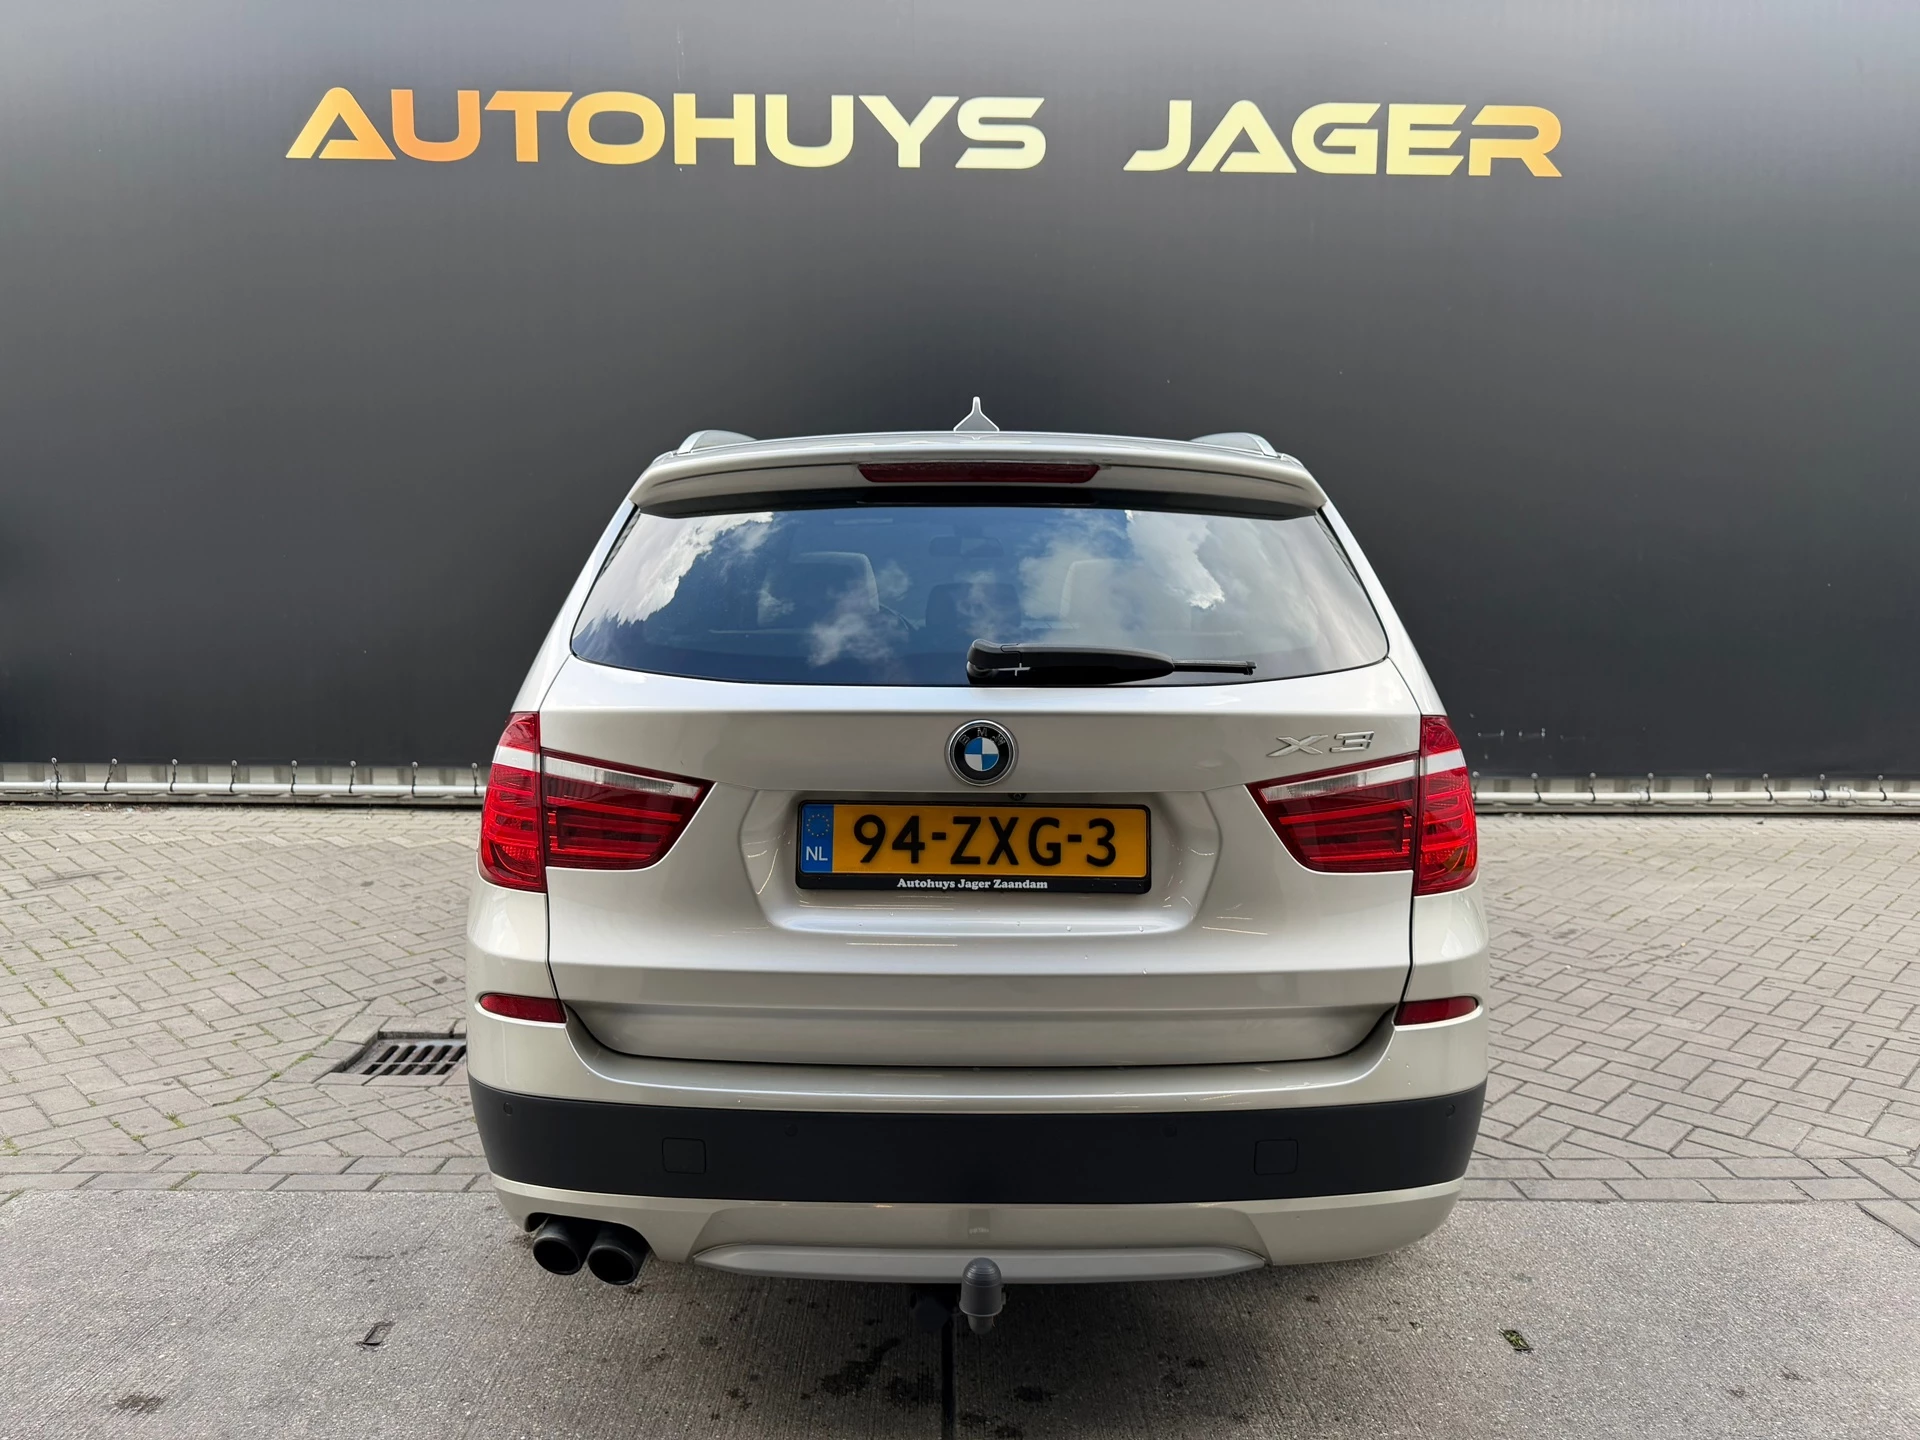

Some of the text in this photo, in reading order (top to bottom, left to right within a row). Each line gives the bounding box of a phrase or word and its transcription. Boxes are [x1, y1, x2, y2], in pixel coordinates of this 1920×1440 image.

[285, 87, 1563, 177] AUTOHUYS JAGER
[959, 727, 1006, 746] BMW
[1266, 730, 1375, 757] X3
[853, 814, 1117, 867] 94-ZXG-3
[805, 846, 828, 861] NL
[897, 878, 1048, 890] Autohuys Jager Zaandam
